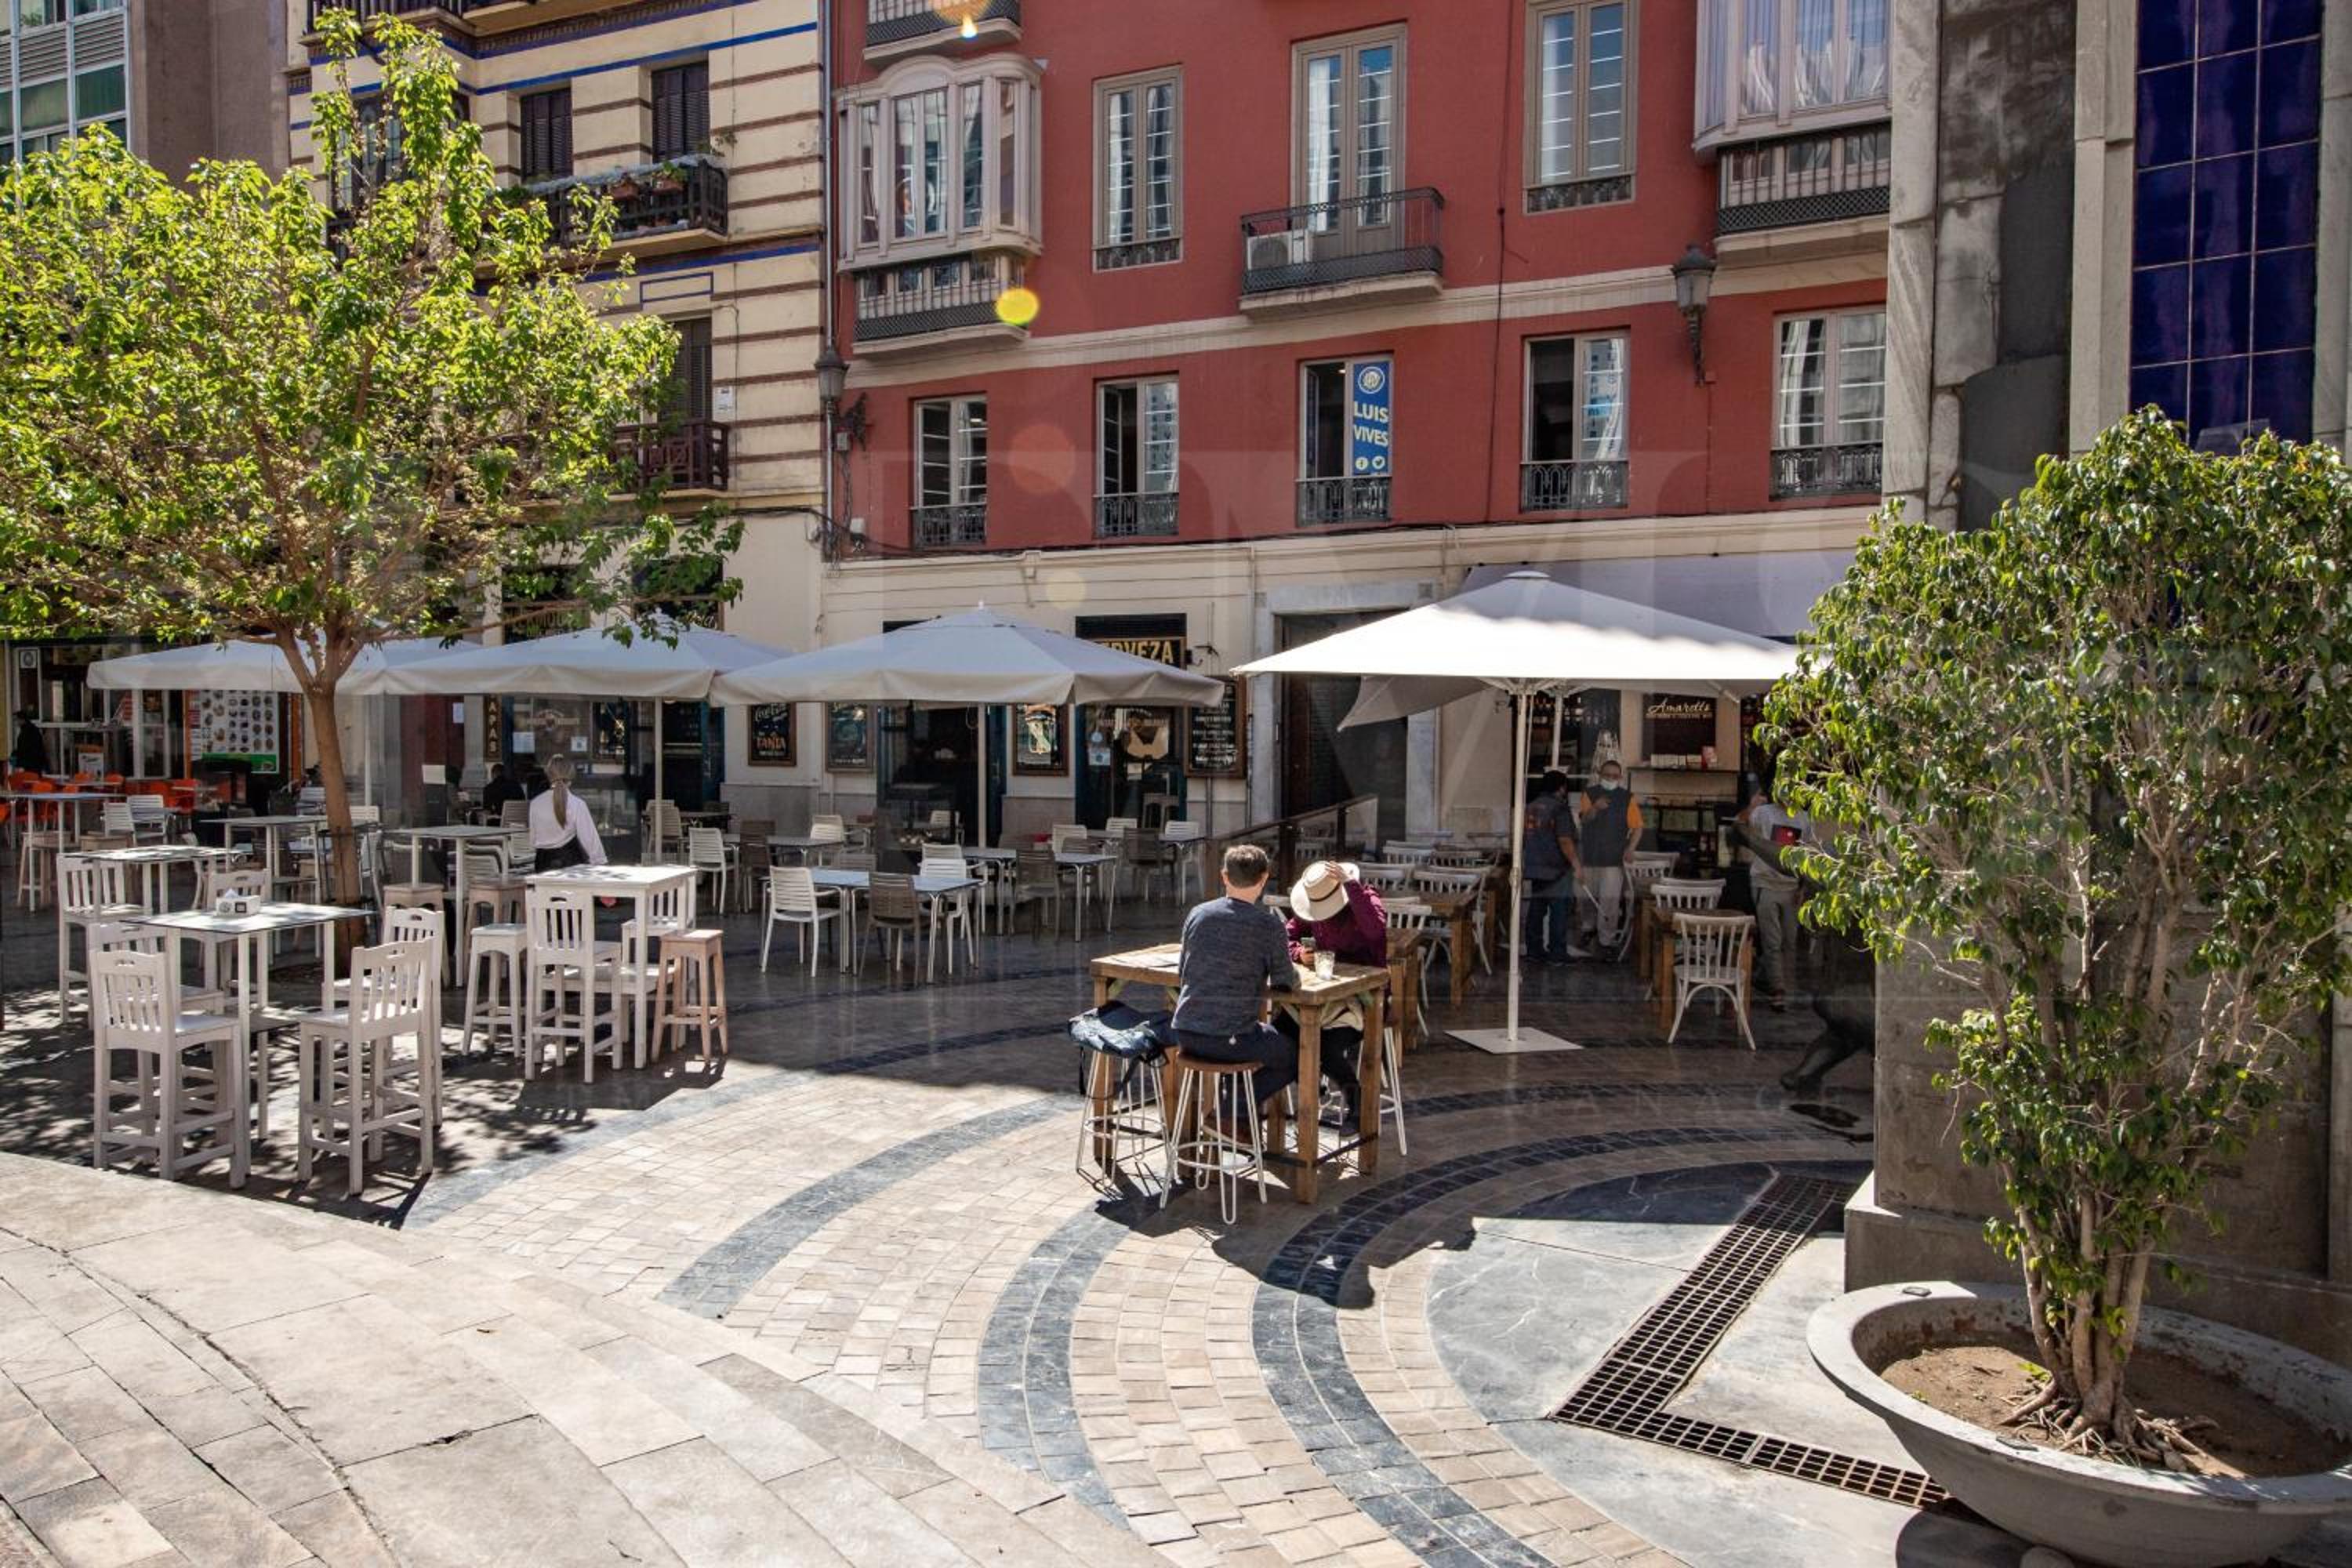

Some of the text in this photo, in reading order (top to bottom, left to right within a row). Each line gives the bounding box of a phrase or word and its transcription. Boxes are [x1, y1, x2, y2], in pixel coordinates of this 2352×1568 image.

[1354, 401, 1388, 423] LUIS
[1354, 424, 1388, 447] VIVES
[1104, 641, 1173, 663] VEZA
